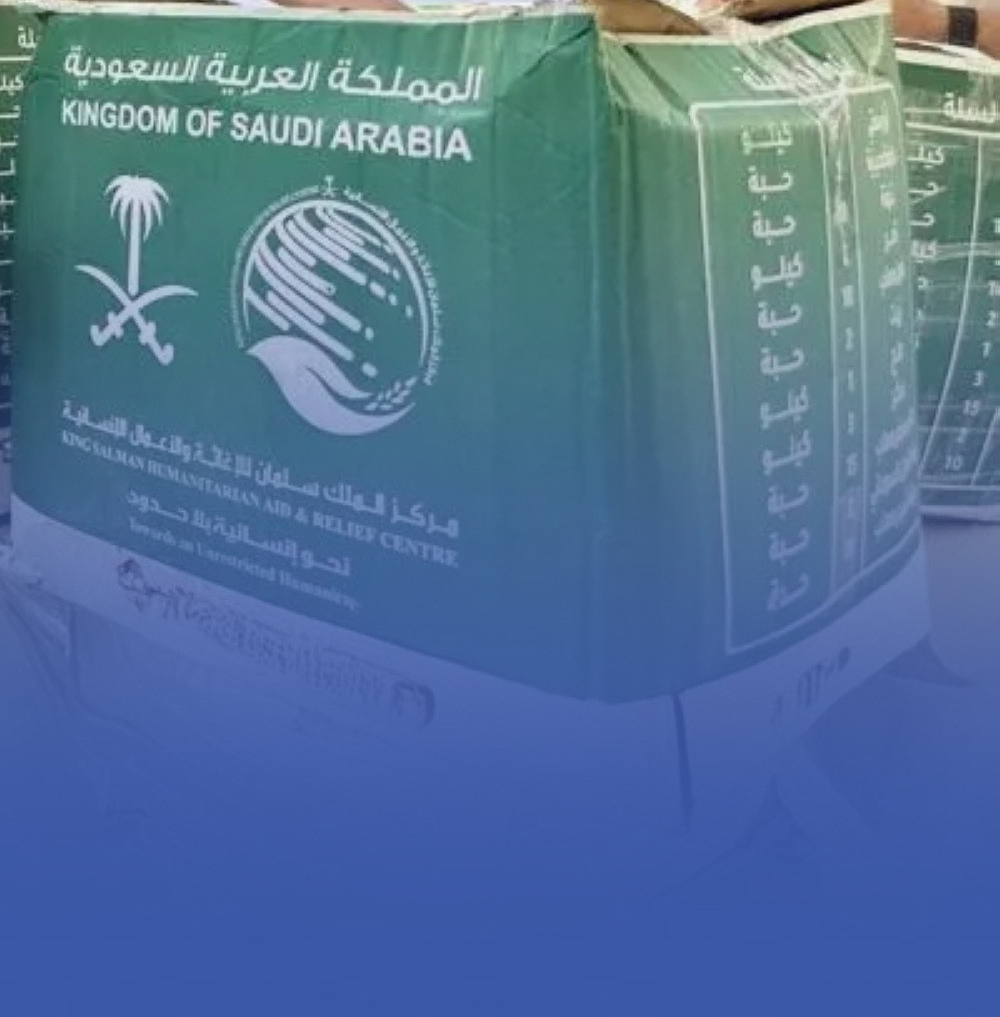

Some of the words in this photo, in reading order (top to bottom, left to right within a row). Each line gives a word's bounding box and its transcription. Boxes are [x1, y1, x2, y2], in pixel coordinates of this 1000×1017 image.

[64, 45, 201, 89] السعودية
[205, 51, 320, 96] العربية
[328, 58, 484, 105] المملكة
[61, 99, 178, 135] KINGDOM
[186, 109, 223, 139] OF
[230, 112, 322, 148] SAUDI
[329, 120, 472, 162] ARABIA
[62, 429, 91, 452] KING
[93, 440, 144, 471] SALMAN
[148, 460, 260, 507] HUMANITARIAN
[264, 497, 291, 517] AID
[294, 507, 308, 524] &
[313, 512, 376, 542] RELIEF
[380, 532, 459, 568] CENTRE
[255, 461, 320, 497] سلمان
[323, 482, 385, 516] الملك
[391, 497, 459, 538] مركز
[300, 550, 351, 577] نحو
